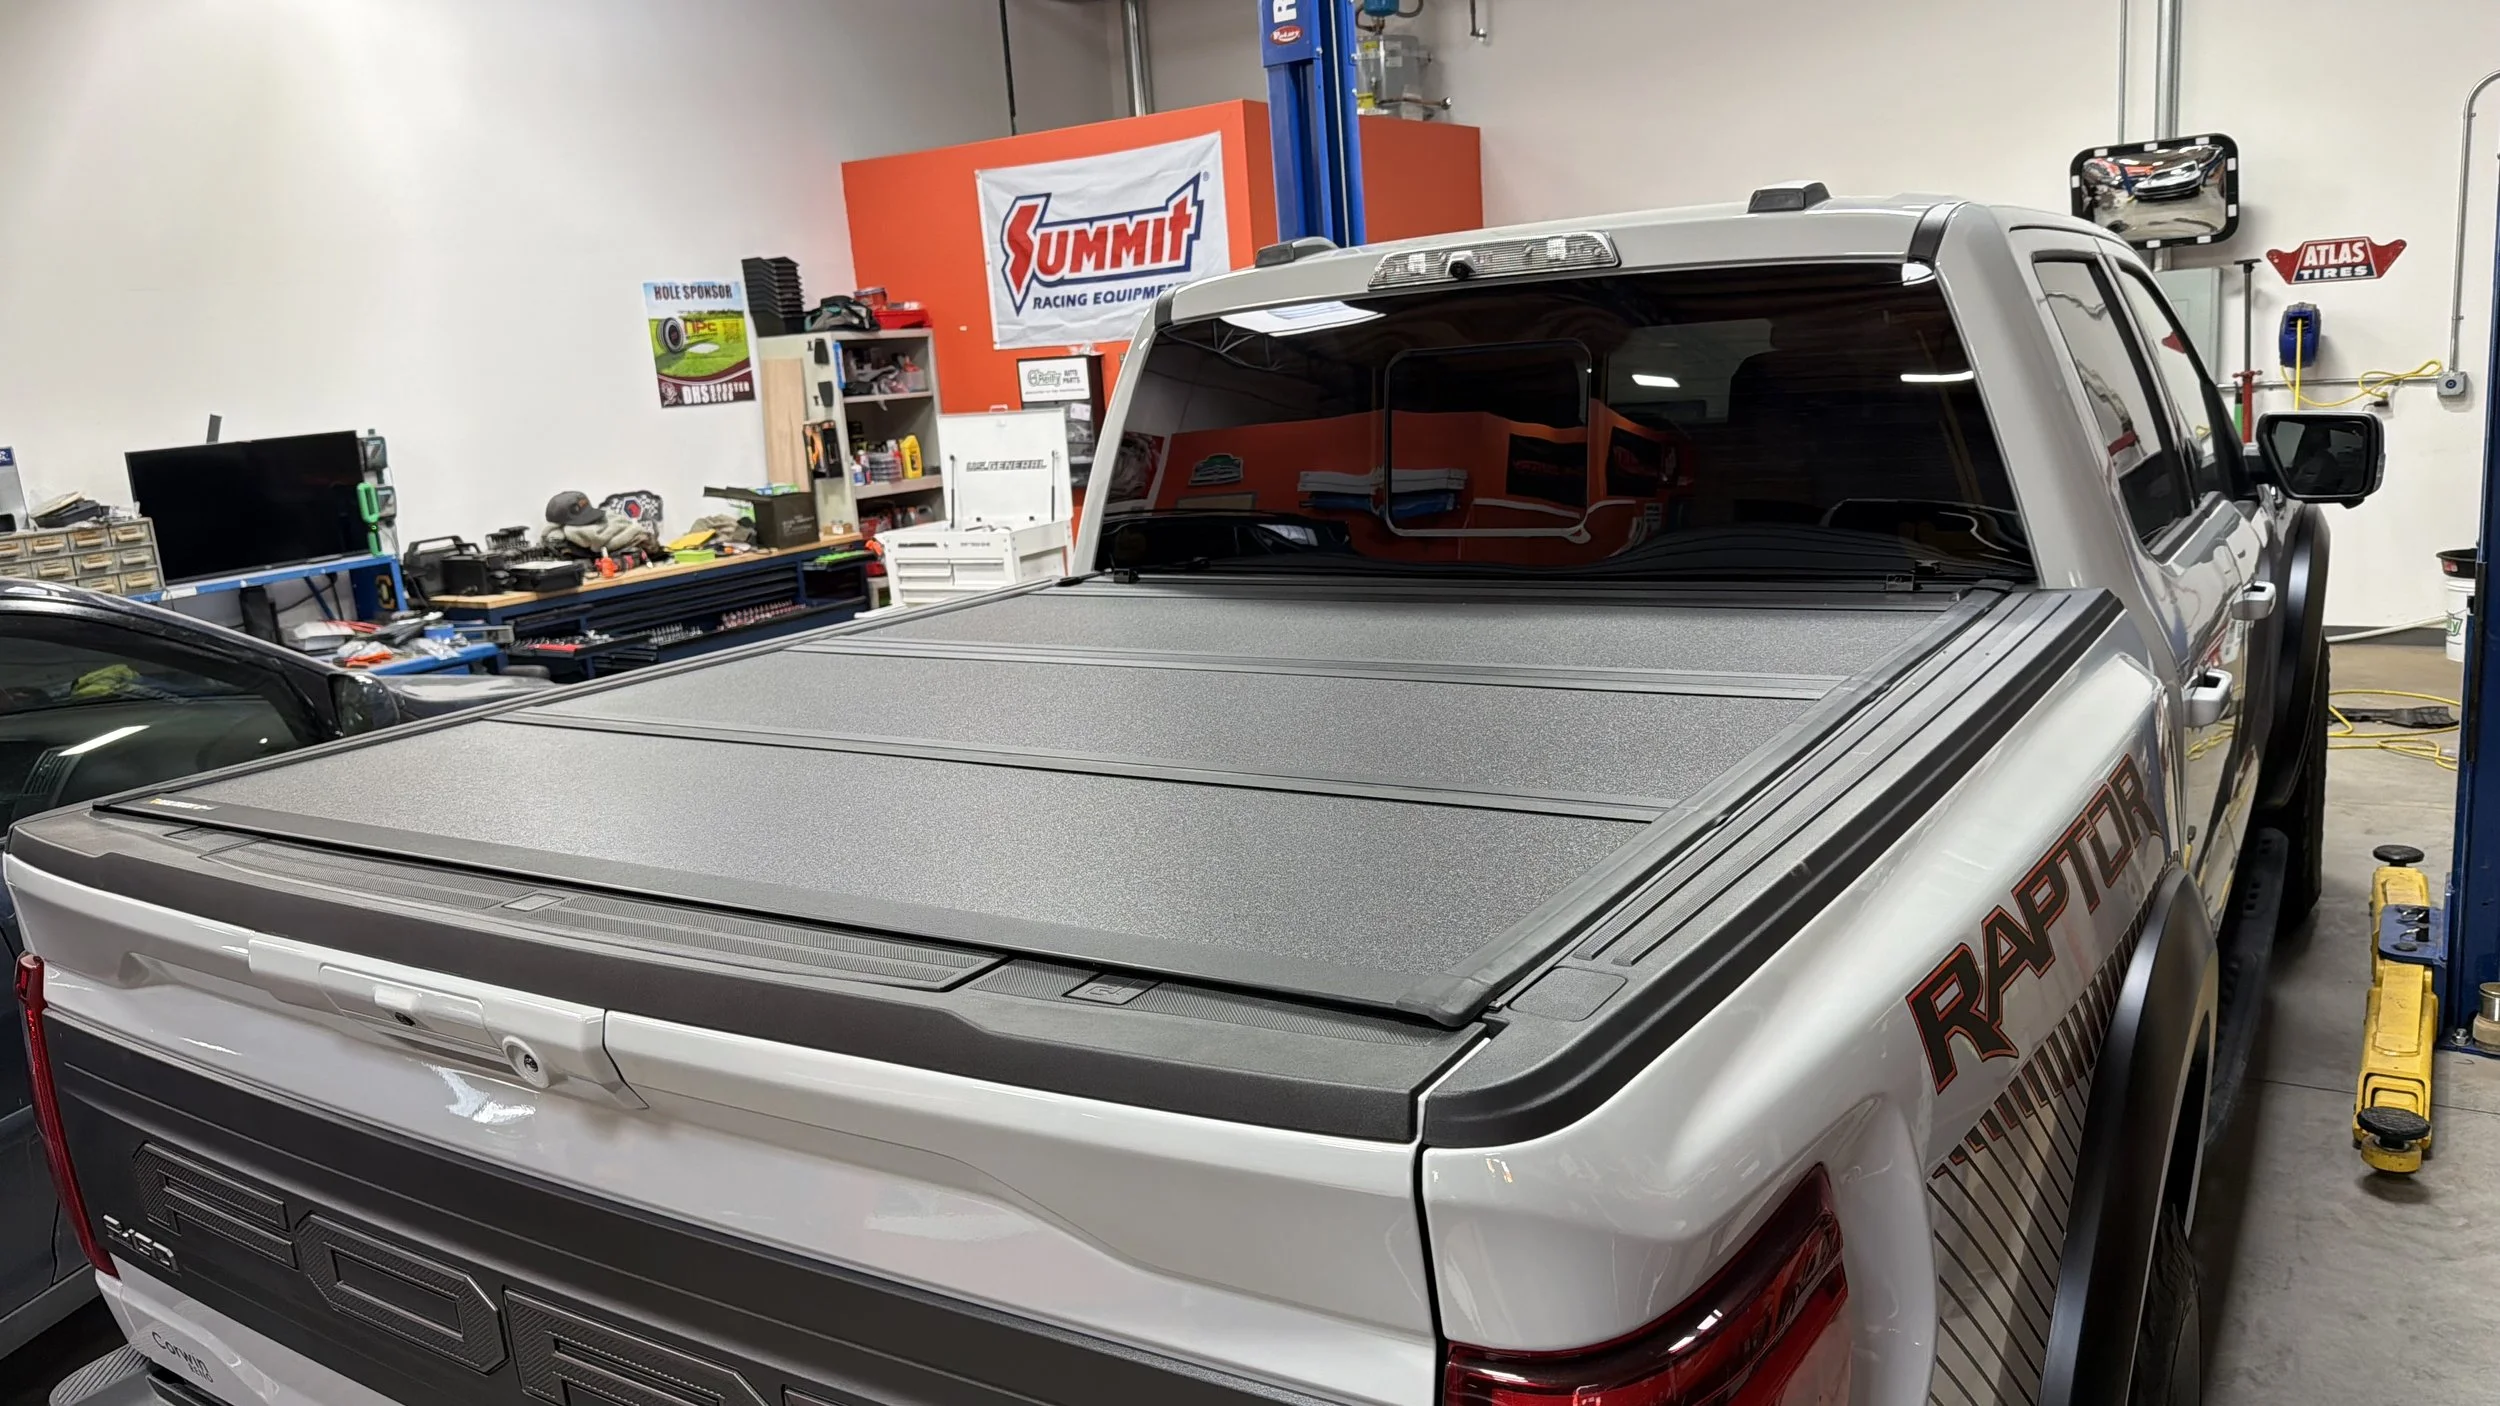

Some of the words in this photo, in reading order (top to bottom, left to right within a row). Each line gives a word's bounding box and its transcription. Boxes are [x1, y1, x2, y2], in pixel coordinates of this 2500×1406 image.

[2303, 241, 2366, 267] ATLAS
[2300, 266, 2368, 280] TIRES
[654, 286, 681, 300] HOLE
[683, 284, 733, 300] SPONSOR
[1032, 293, 1088, 310] RACING
[988, 459, 1047, 471] GENERAL
[1905, 752, 2163, 1095] RAPTOR
[151, 1331, 210, 1374] Corwin
